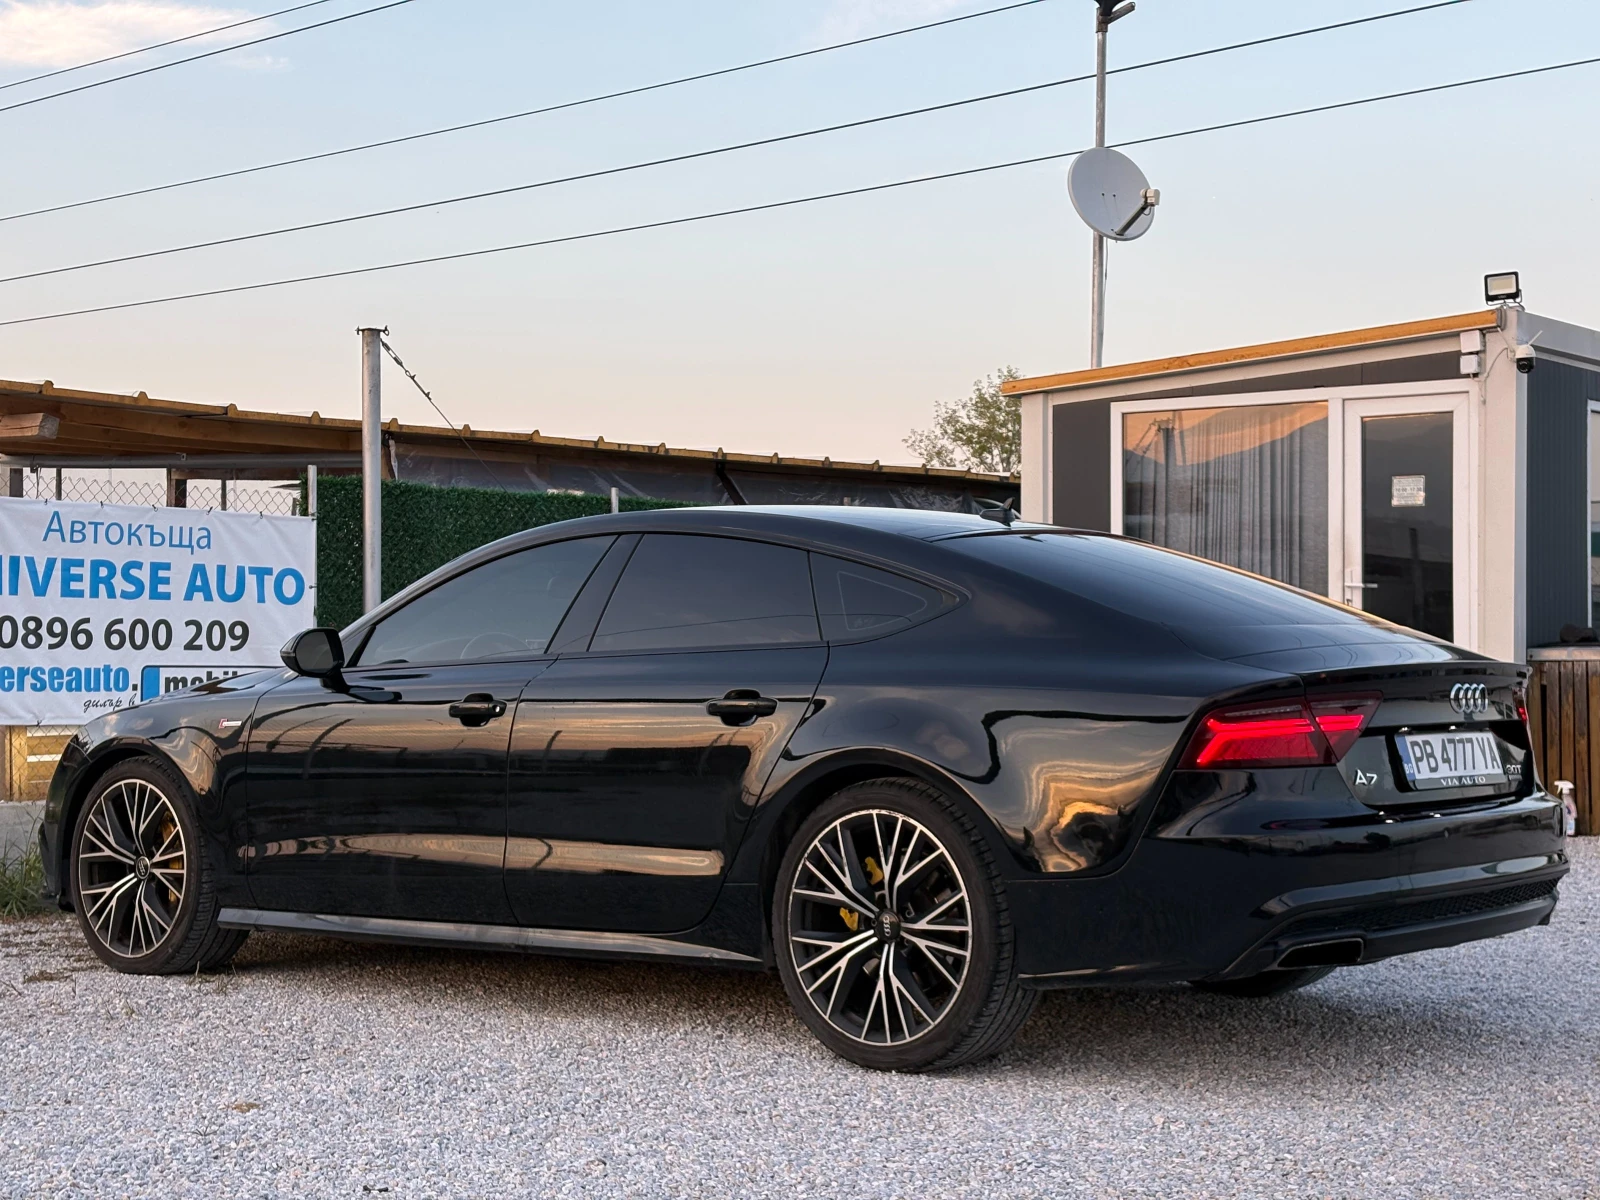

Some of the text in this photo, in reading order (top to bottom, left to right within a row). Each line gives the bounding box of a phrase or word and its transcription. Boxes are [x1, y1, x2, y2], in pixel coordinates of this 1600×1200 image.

[42, 510, 212, 555] Автокъща
[0, 555, 305, 606] IVERSE AUTO
[0, 615, 250, 651] 0896 600 209
[1404, 763, 1414, 774] BG
[1409, 736, 1501, 774] PB 4777 YA
[1355, 769, 1377, 786] A7
[1440, 776, 1487, 786] VIA AUTO
